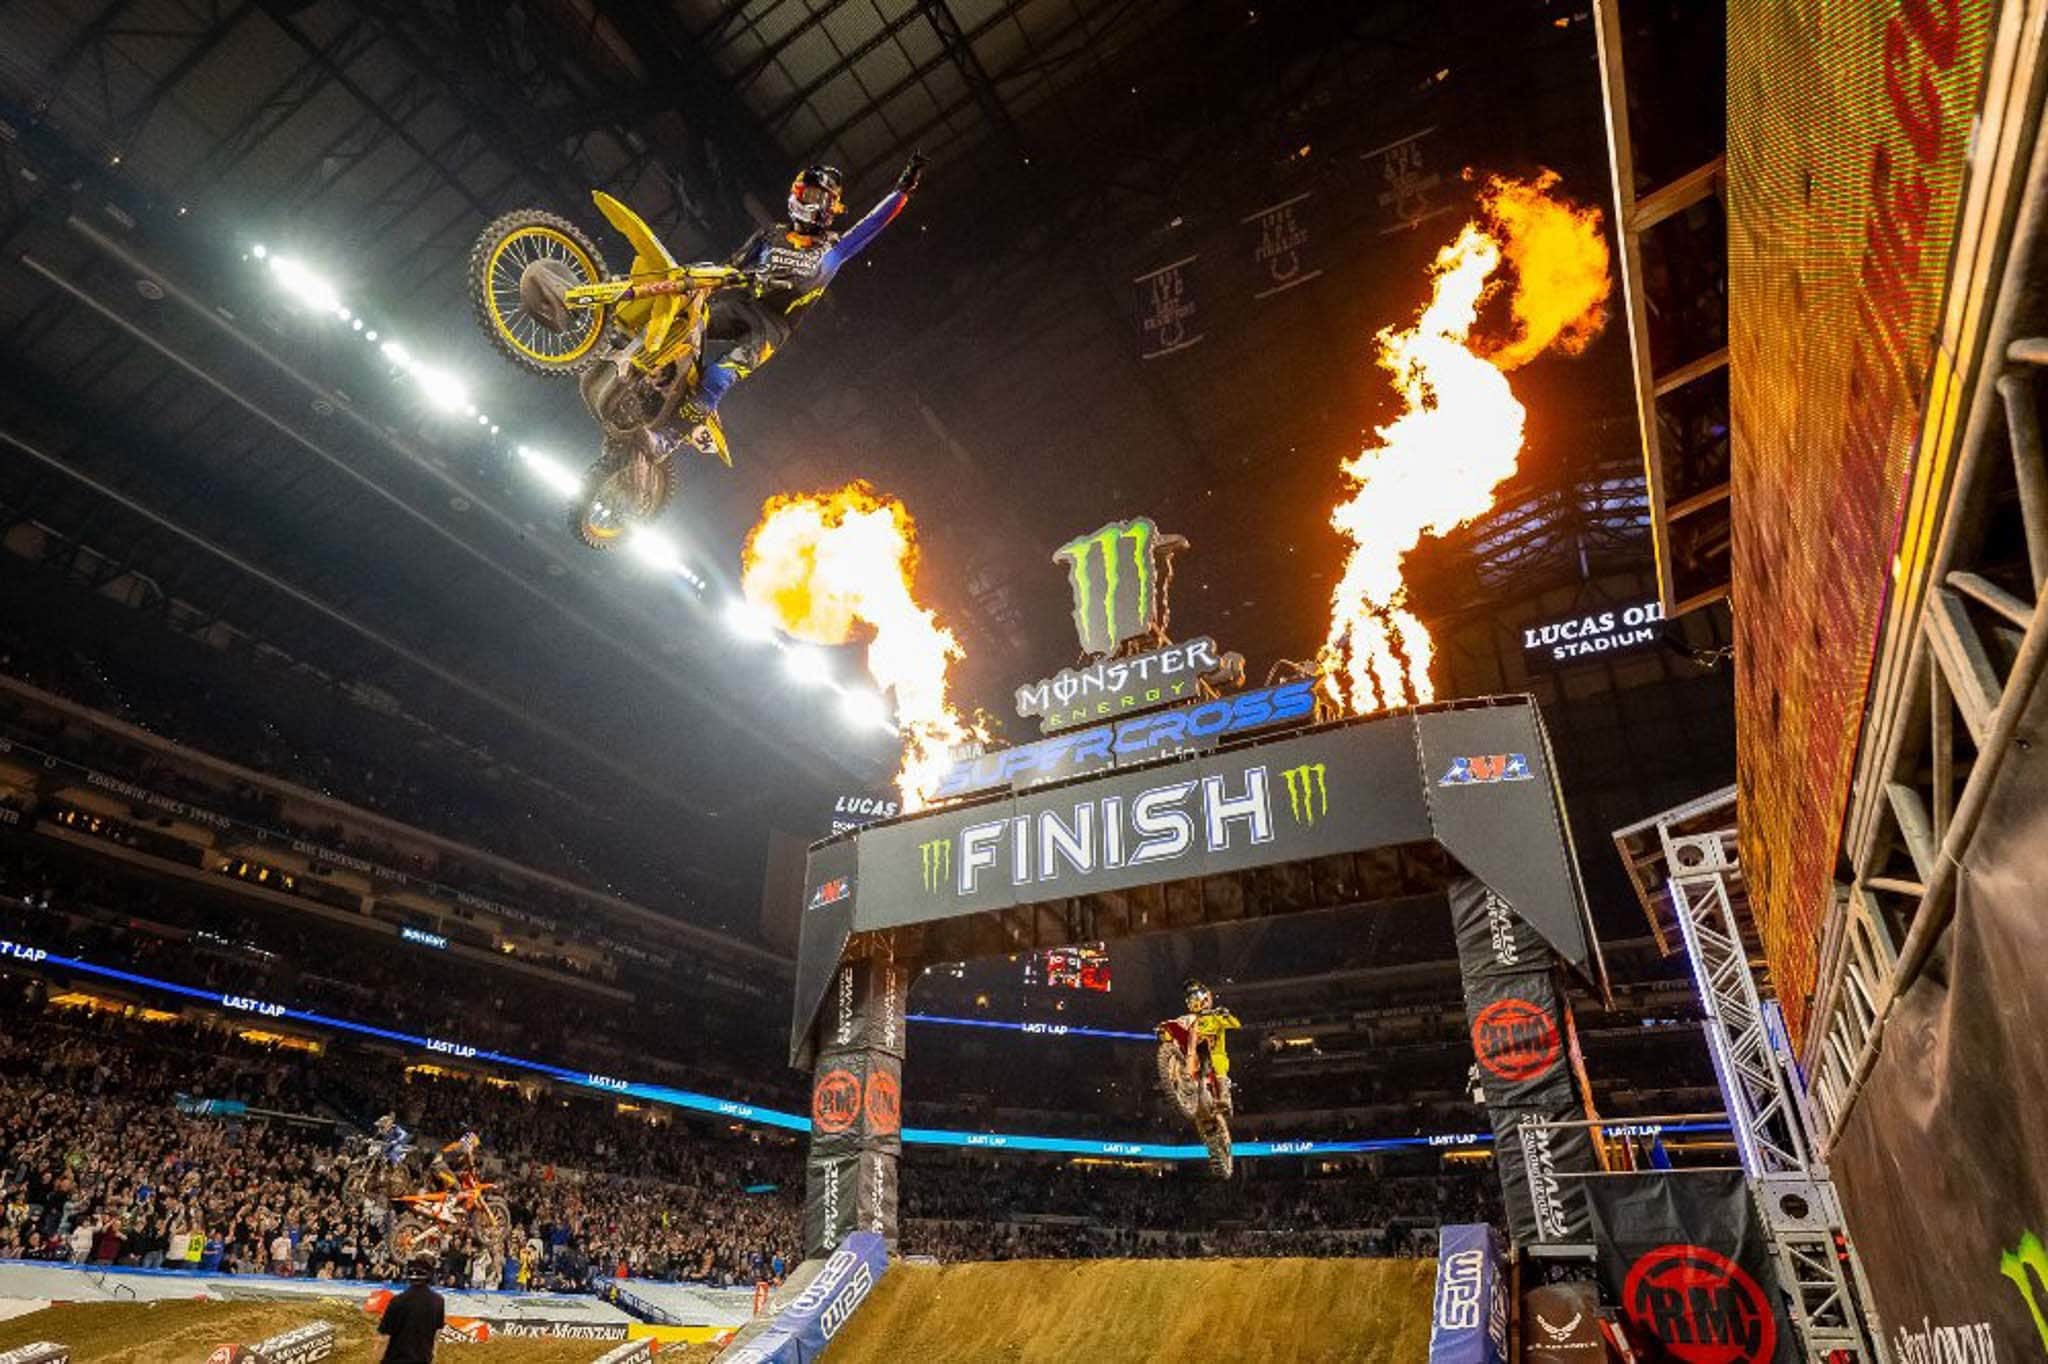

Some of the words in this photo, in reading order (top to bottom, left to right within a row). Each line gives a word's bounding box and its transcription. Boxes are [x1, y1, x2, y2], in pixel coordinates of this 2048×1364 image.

[1524, 612, 1615, 649] LUCAS
[1553, 628, 1655, 661] STADIUM
[1019, 640, 1218, 714] MONSTER
[1049, 680, 1187, 727] ENERGY
[834, 796, 898, 818] LUCAS
[957, 764, 1274, 898] FINISH
[13, 945, 47, 964] LAP
[222, 993, 258, 1012] LAST
[258, 1000, 286, 1018] LAP
[1021, 1022, 1045, 1034] LAST
[1046, 1024, 1068, 1036] LAP
[426, 1037, 455, 1054] LAST
[455, 1044, 477, 1059] LAP
[589, 1073, 611, 1088] LAST
[611, 1078, 628, 1090] LAP
[719, 1102, 736, 1114] LAST
[735, 1105, 753, 1116] LAP
[967, 1134, 988, 1145] LAST
[988, 1135, 1007, 1146] LAP
[1428, 1133, 1455, 1146] LAST
[1456, 1133, 1478, 1145] LAP
[1636, 1124, 1663, 1138] LAP
[1103, 1143, 1122, 1153] LAST
[1122, 1144, 1142, 1154] LAP
[1271, 1143, 1291, 1153] LAST
[1292, 1142, 1313, 1153] LAP
[1440, 1250, 1484, 1331] WPS
[820, 1264, 874, 1342] WPS
[503, 1321, 550, 1338] ROCKY
[552, 1322, 627, 1341] MOUNTAIN
